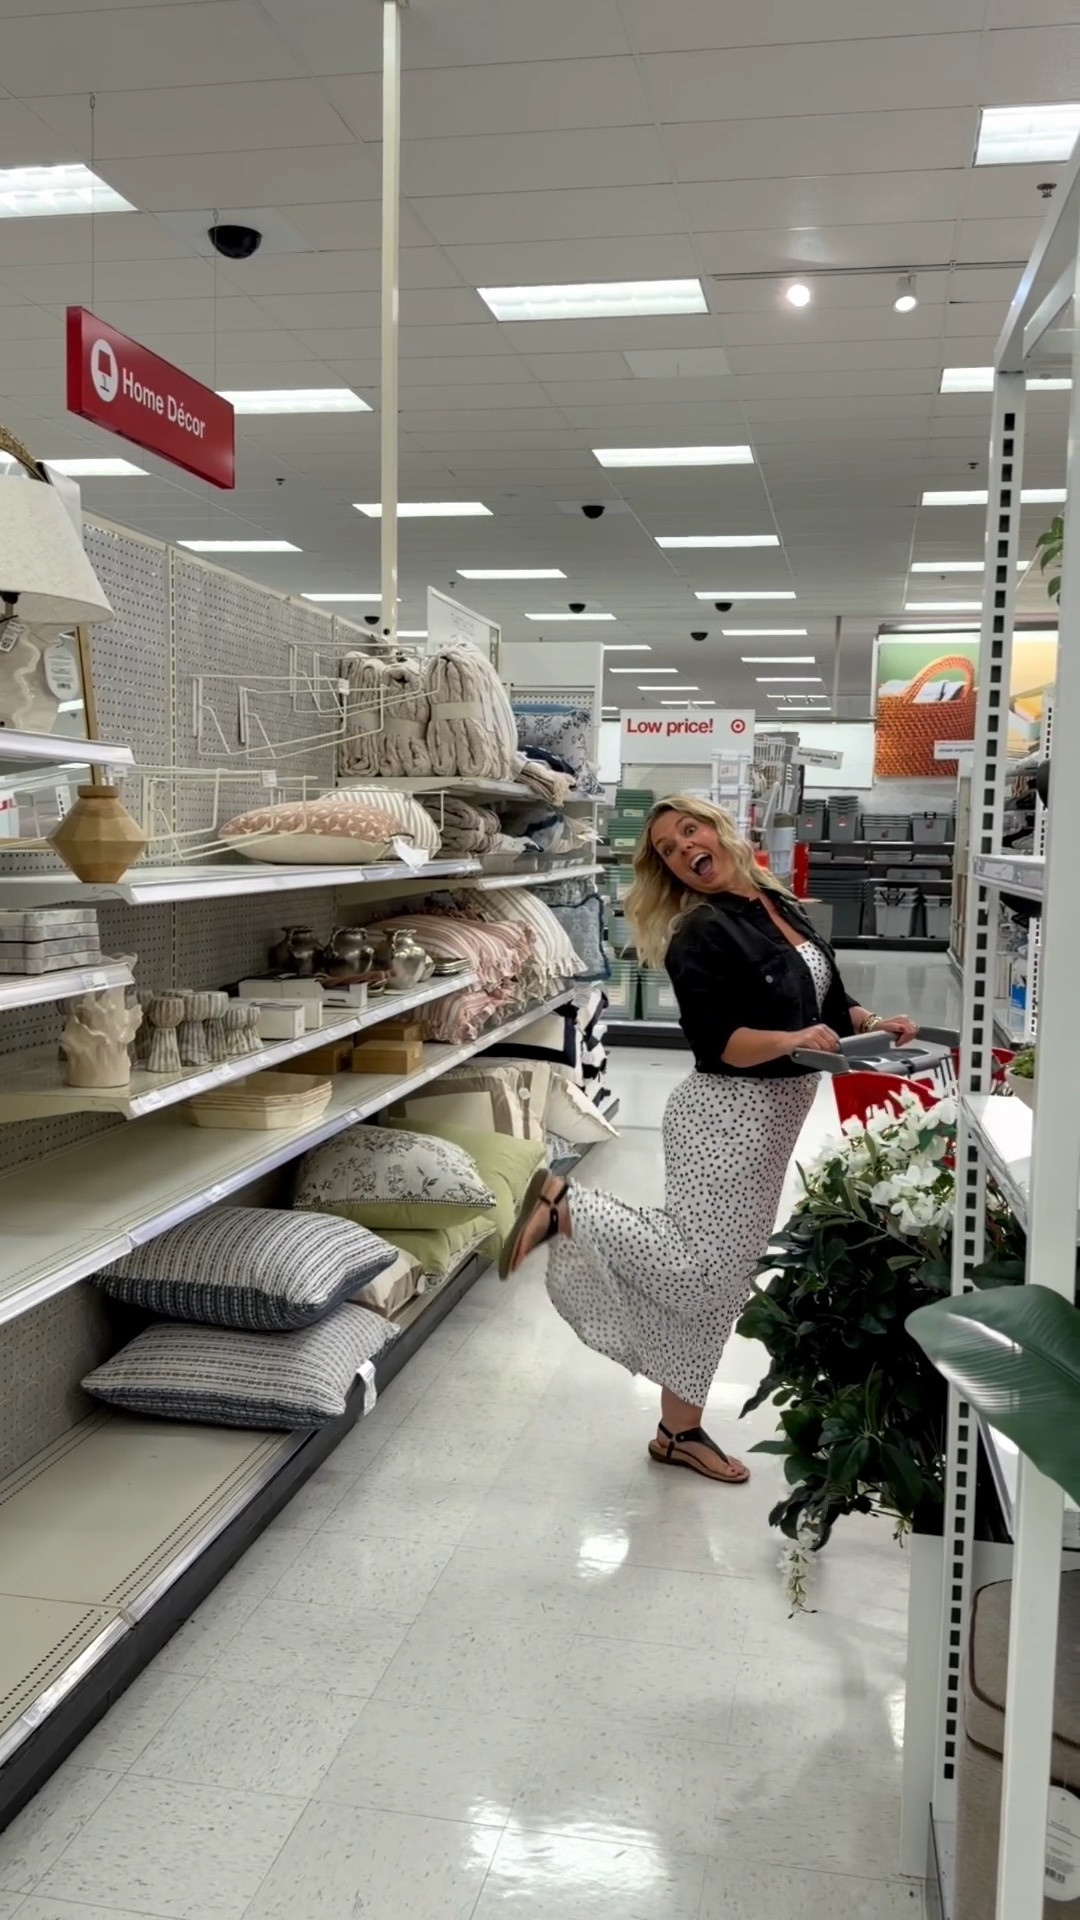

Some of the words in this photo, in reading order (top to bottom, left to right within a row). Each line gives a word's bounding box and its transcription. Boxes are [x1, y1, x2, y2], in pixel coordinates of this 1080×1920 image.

[122, 367, 164, 415] Home
[167, 394, 206, 438] Décor
[627, 718, 662, 734] Low
[666, 718, 714, 736] price!
